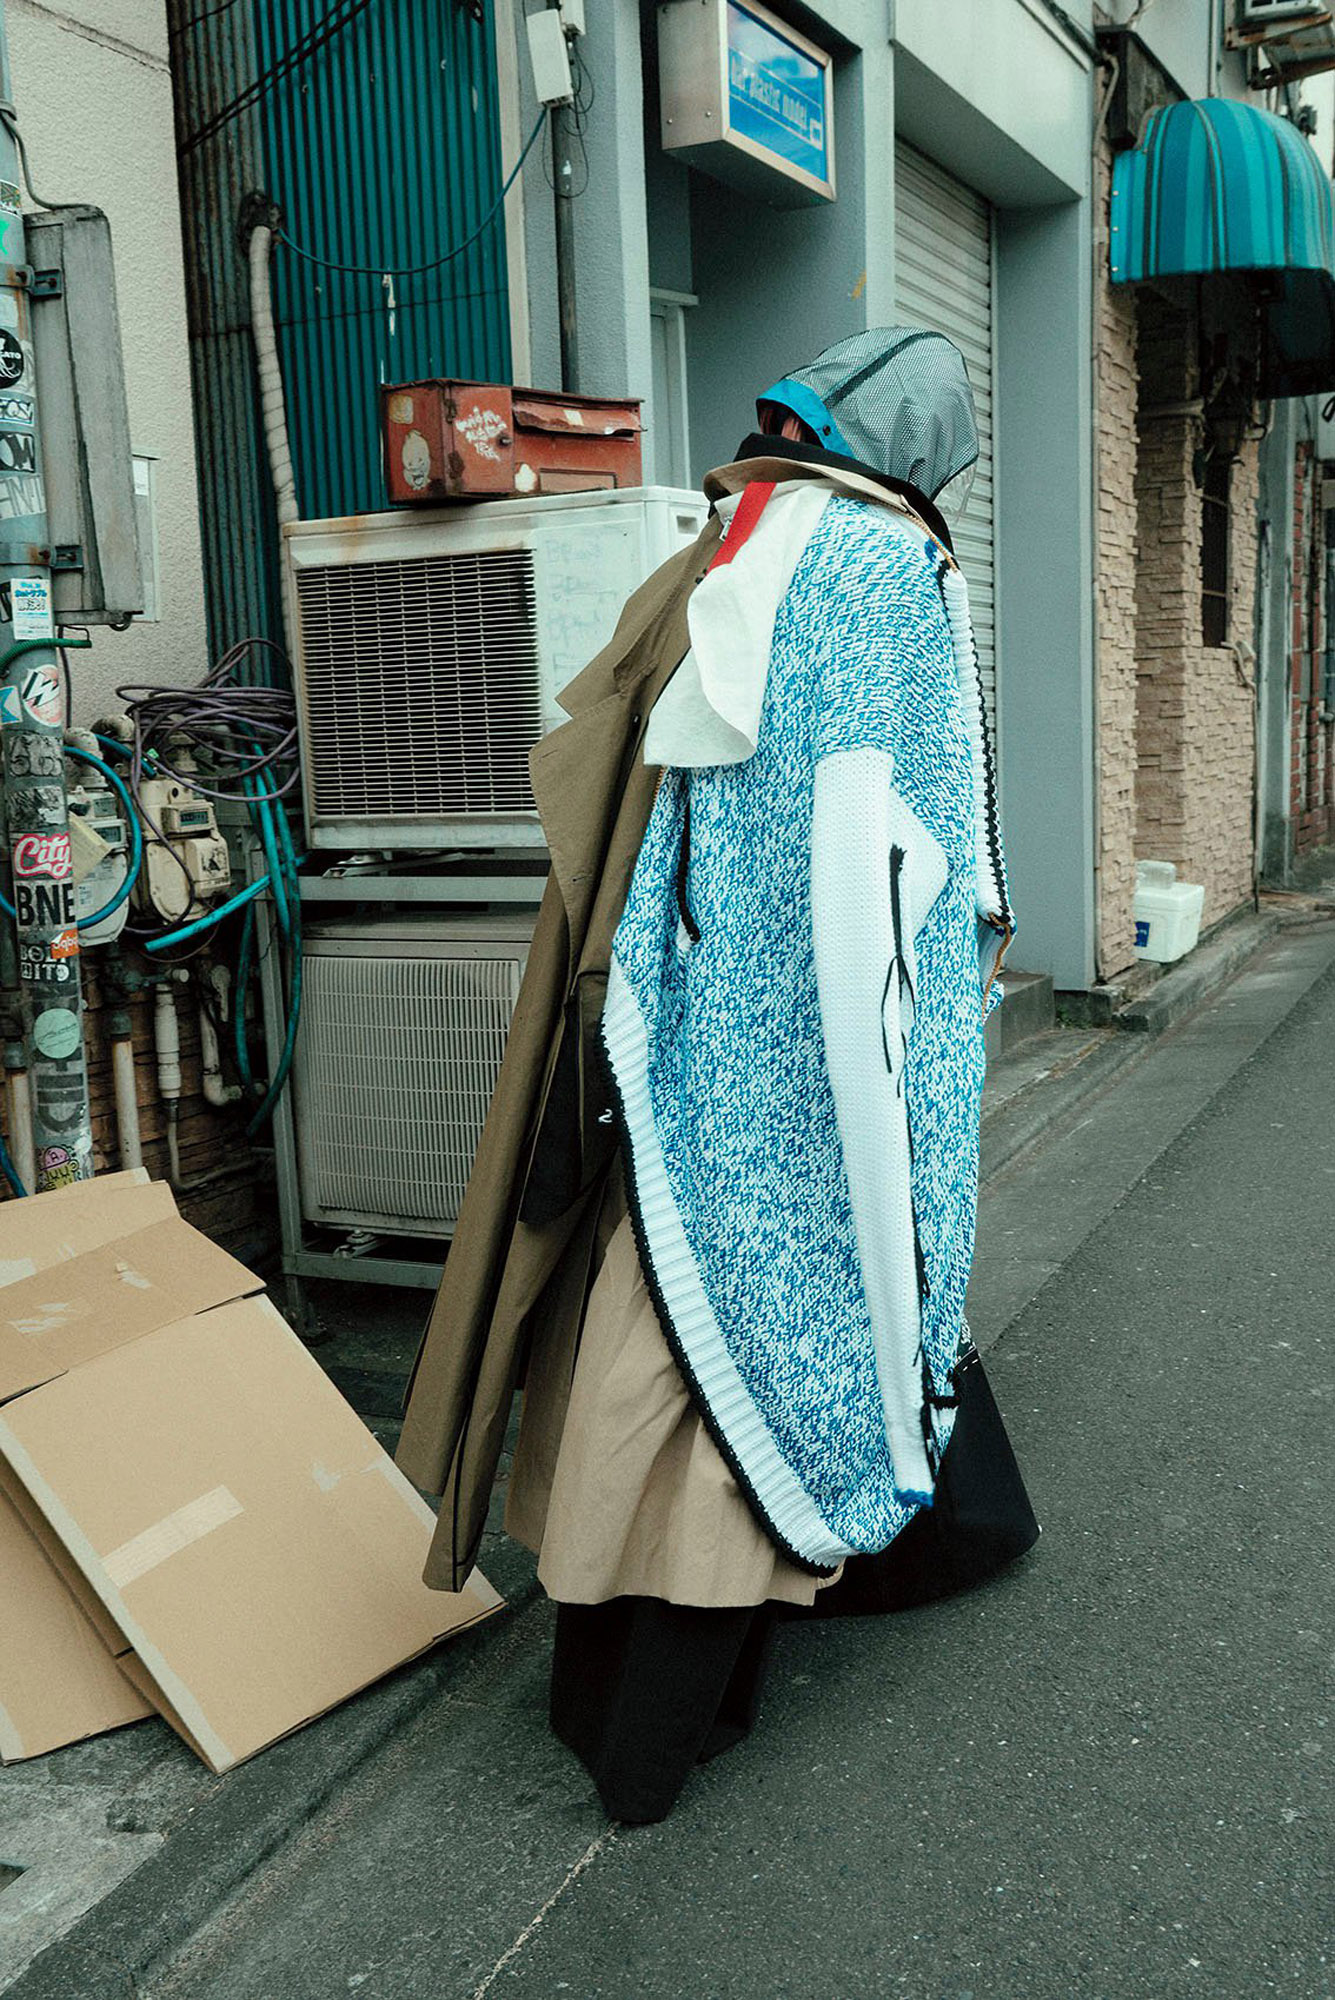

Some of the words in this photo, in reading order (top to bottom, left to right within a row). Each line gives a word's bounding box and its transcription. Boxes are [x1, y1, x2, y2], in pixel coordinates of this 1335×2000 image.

[749, 74, 780, 114] plastic
[782, 94, 807, 131] model
[15, 834, 72, 878] City
[16, 883, 76, 926] BNE
